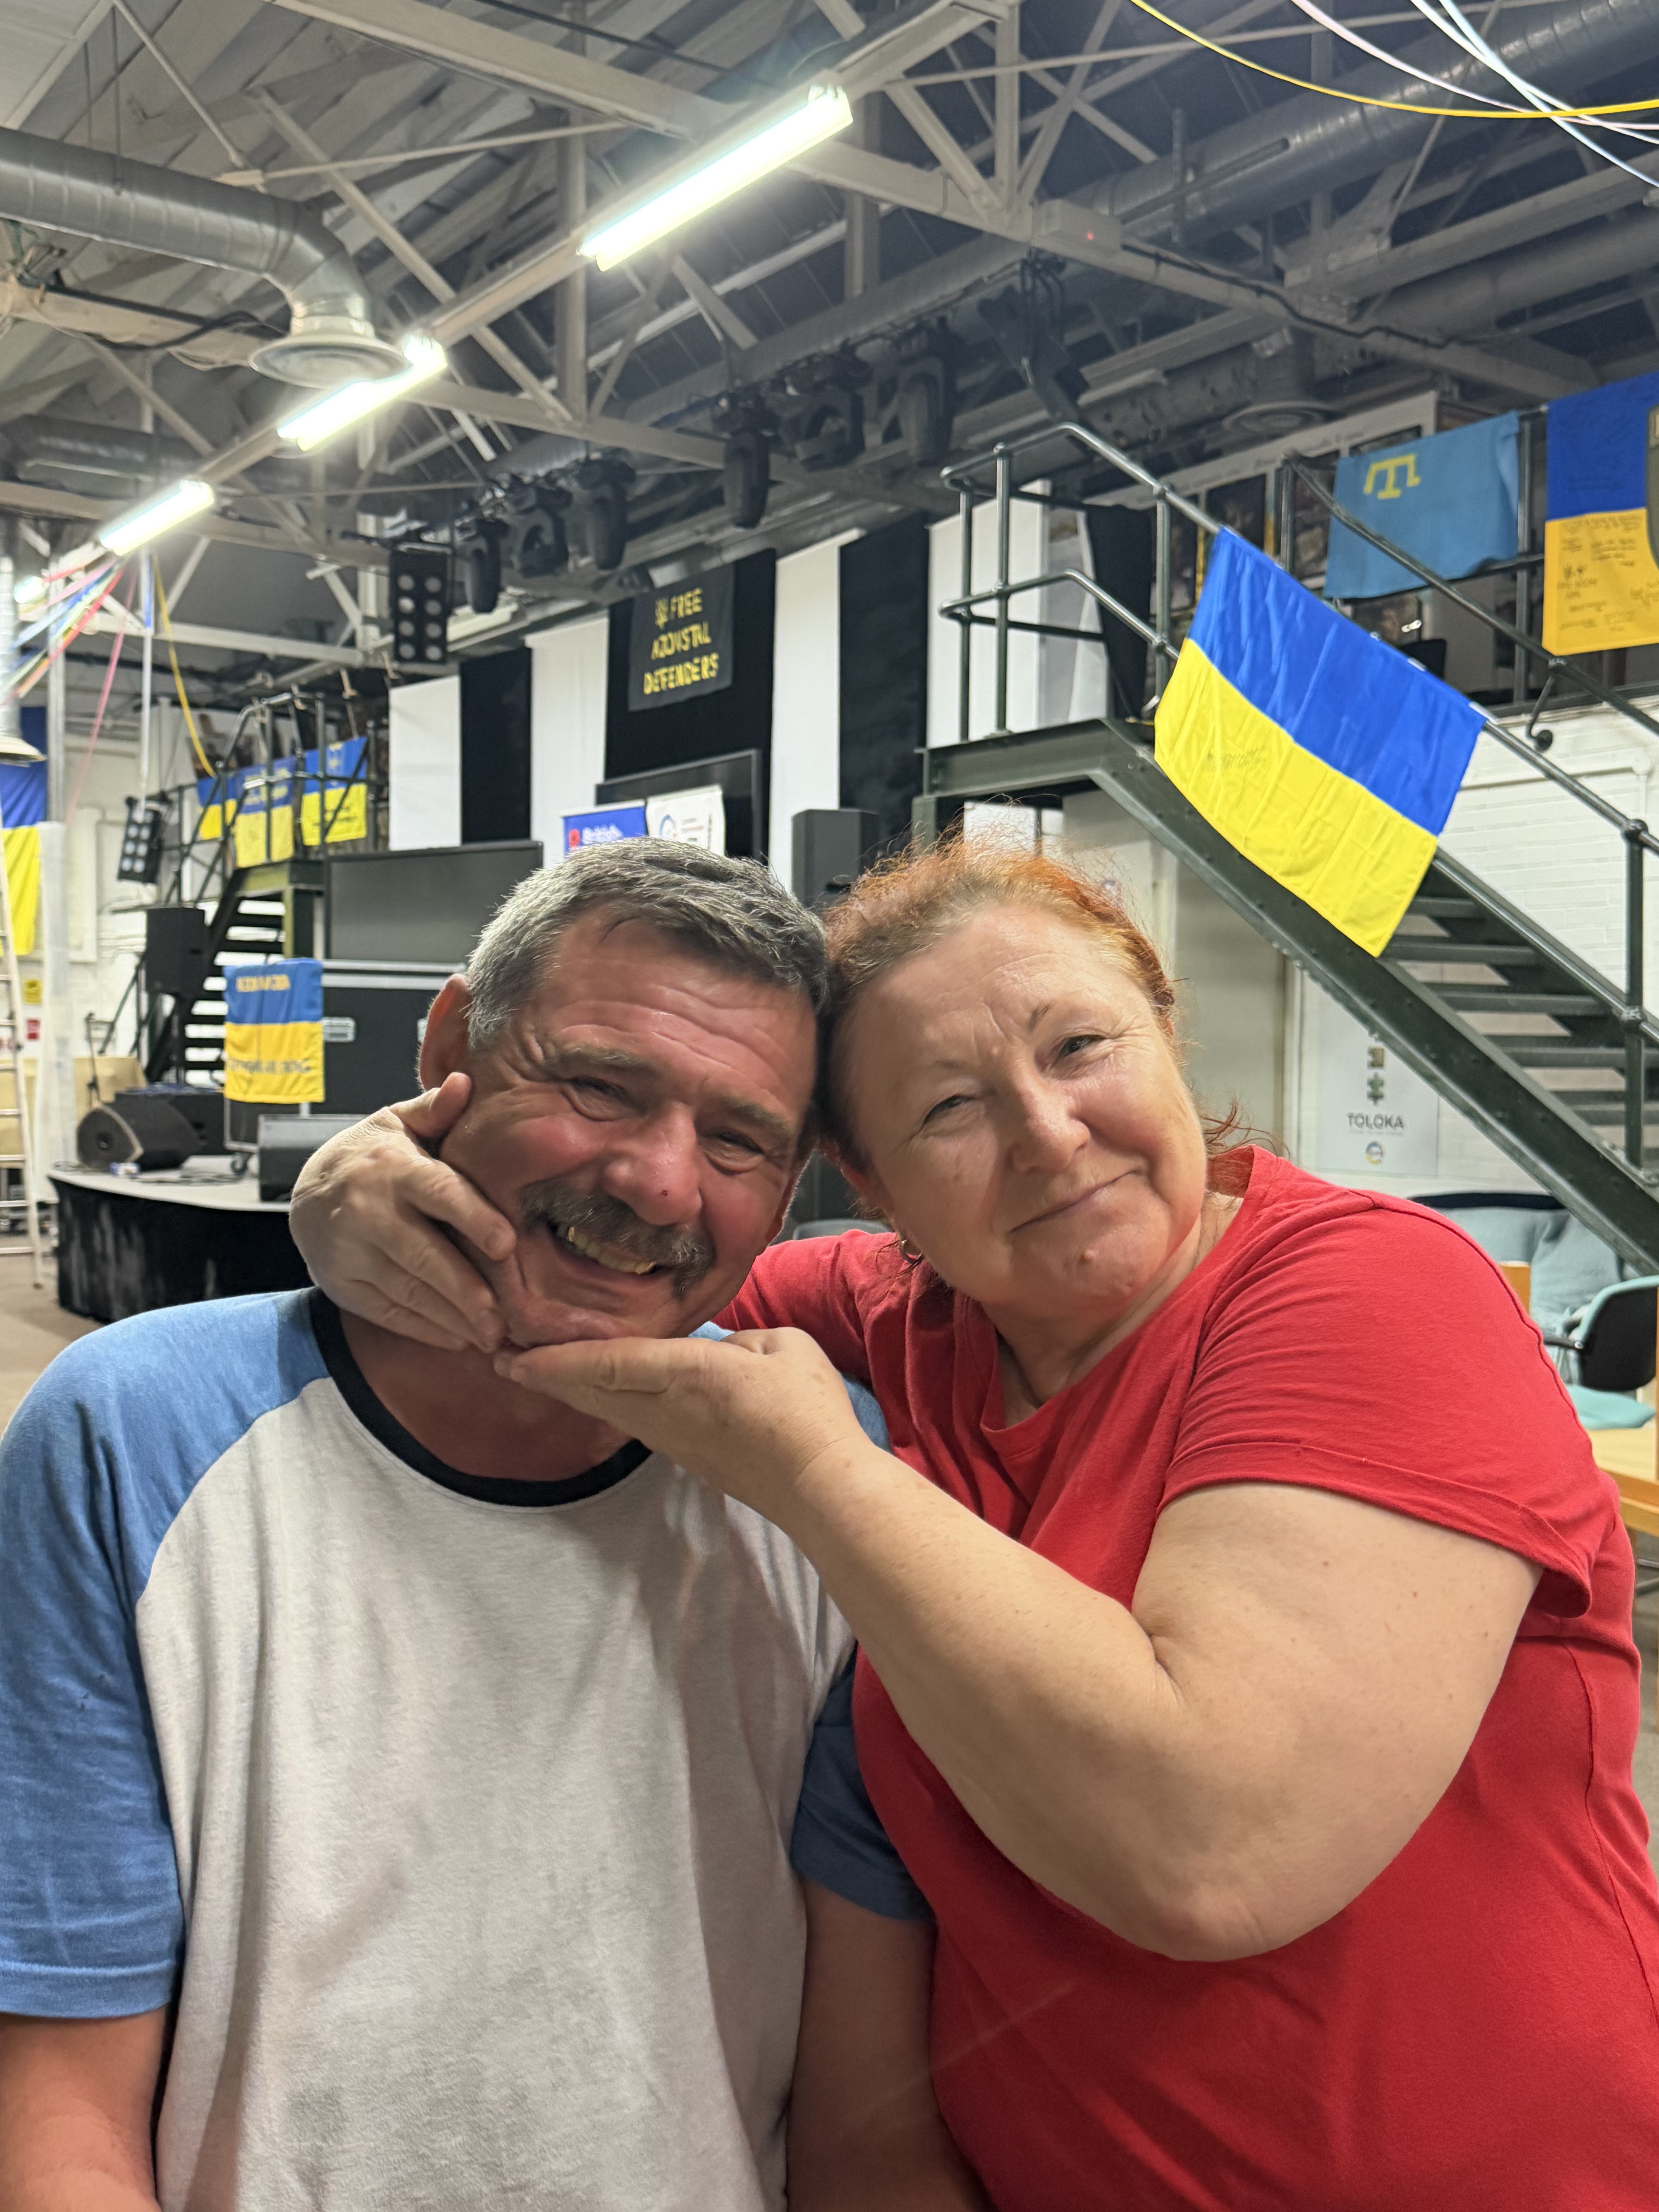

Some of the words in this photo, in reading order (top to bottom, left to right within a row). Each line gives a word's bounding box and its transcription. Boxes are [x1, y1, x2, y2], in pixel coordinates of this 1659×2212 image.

[670, 587, 702, 619] FREE
[651, 621, 711, 660] AZOVSTAL
[643, 653, 718, 695] DEFENDERS
[1347, 1113, 1405, 1130] TOLOKA
